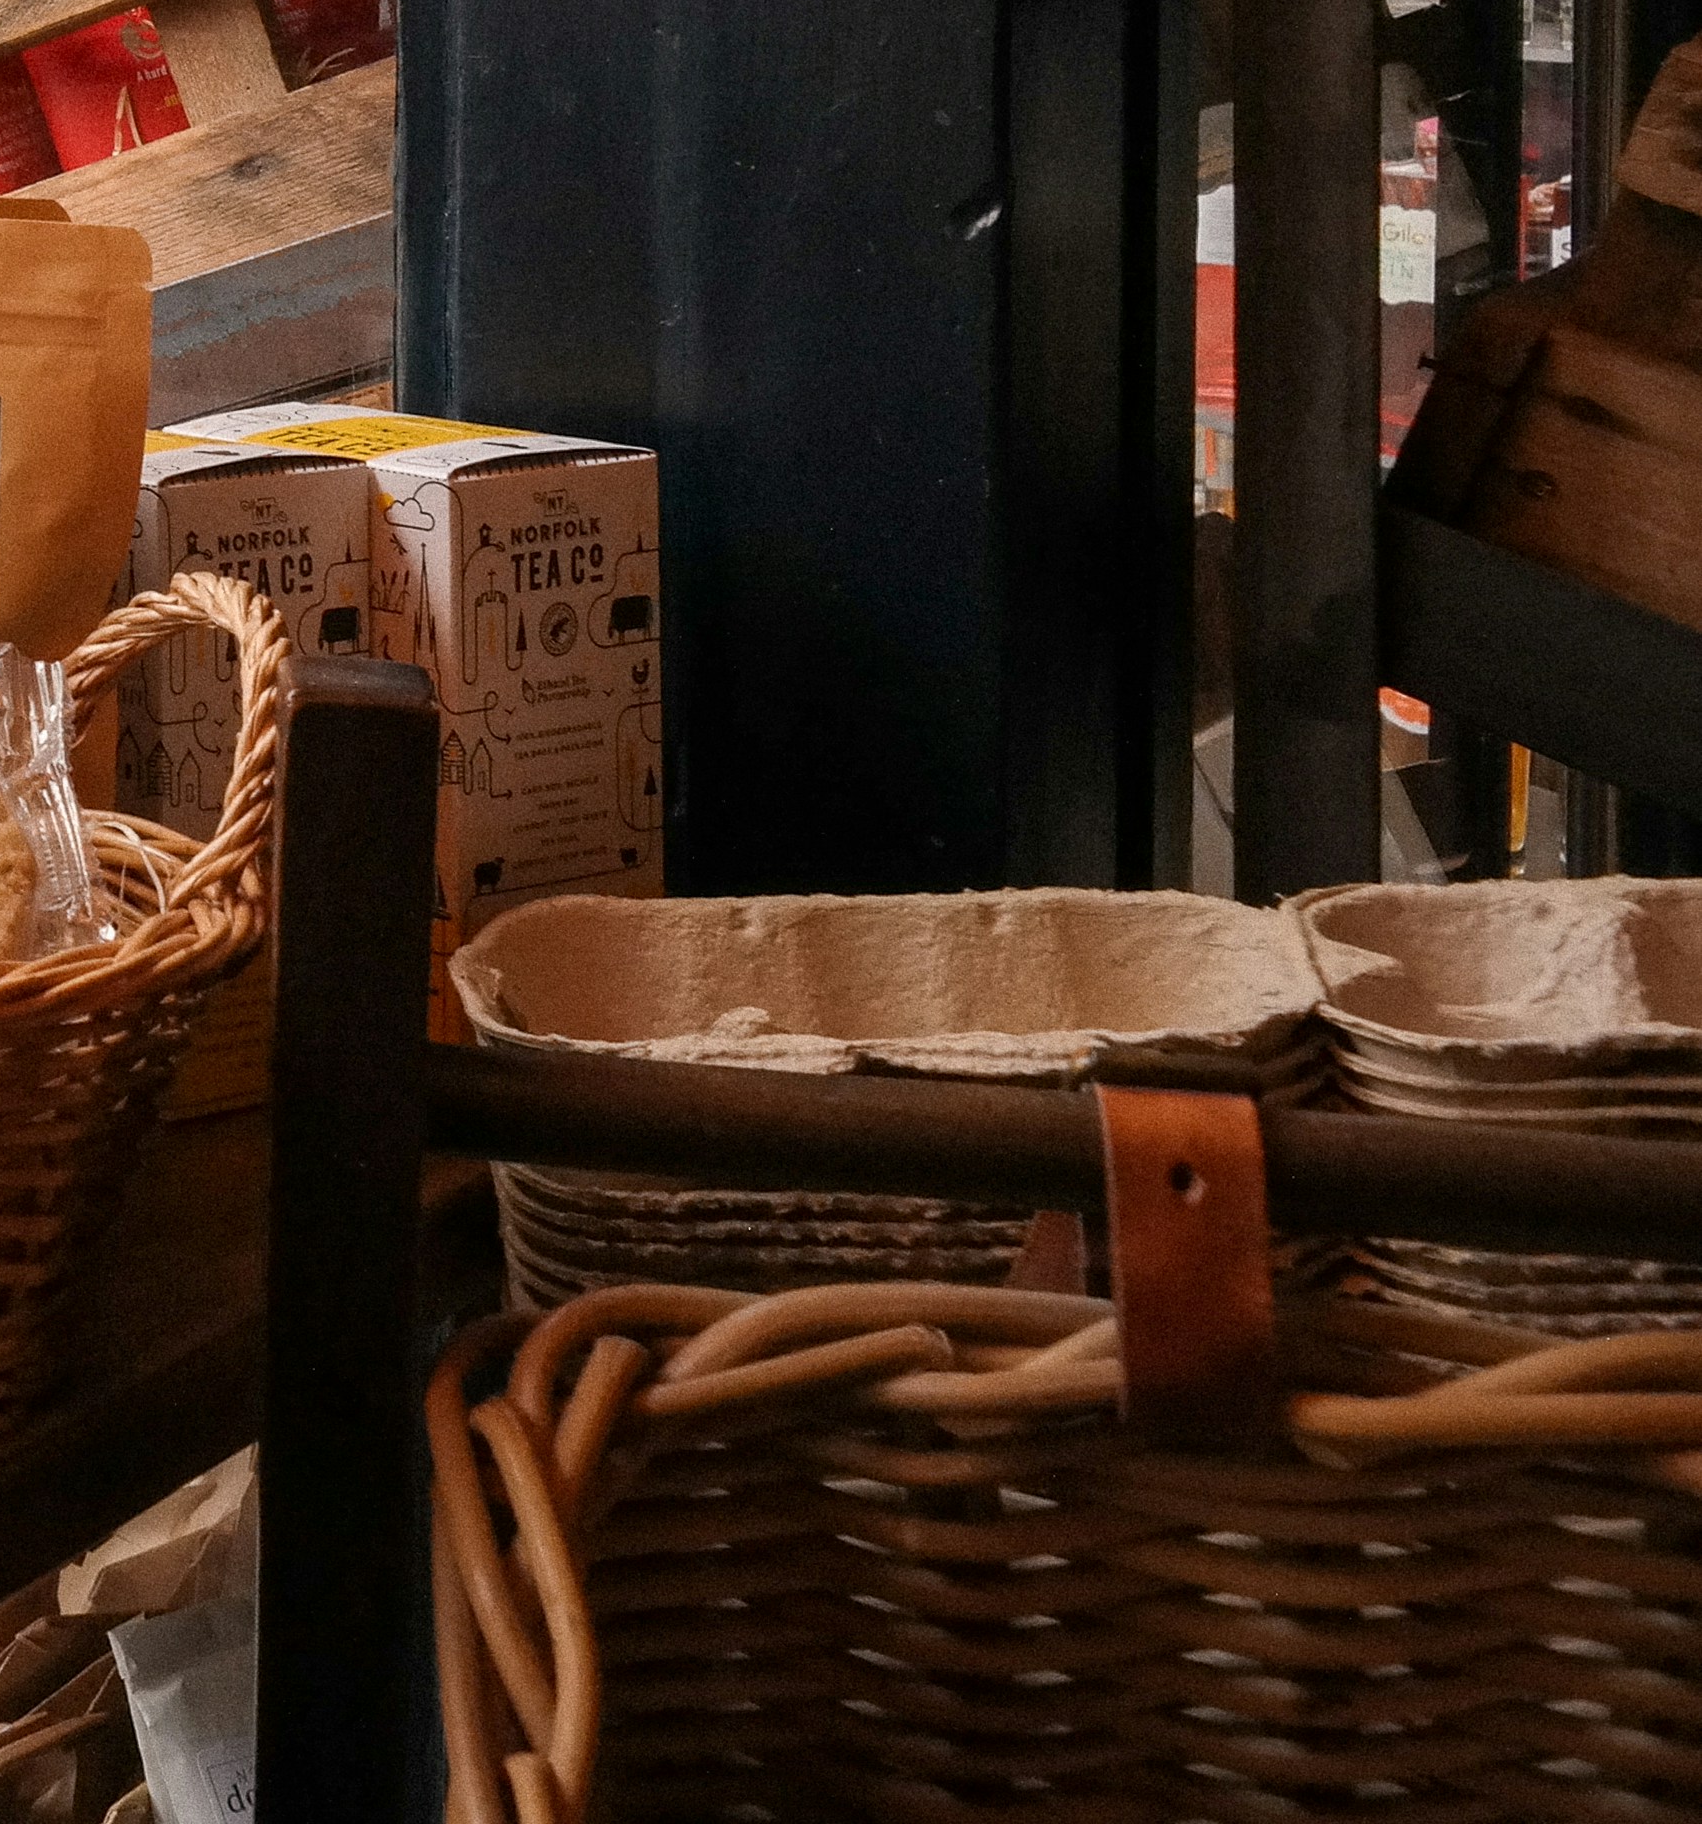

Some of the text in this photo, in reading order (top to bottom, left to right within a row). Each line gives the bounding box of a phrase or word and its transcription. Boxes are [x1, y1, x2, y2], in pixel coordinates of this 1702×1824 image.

[144, 65, 169, 82] hard
[255, 504, 271, 518] NT
[547, 495, 564, 511] NT
[217, 526, 310, 554] NORFOLK
[510, 517, 601, 545] NORFOLK
[510, 549, 562, 593] TEA
